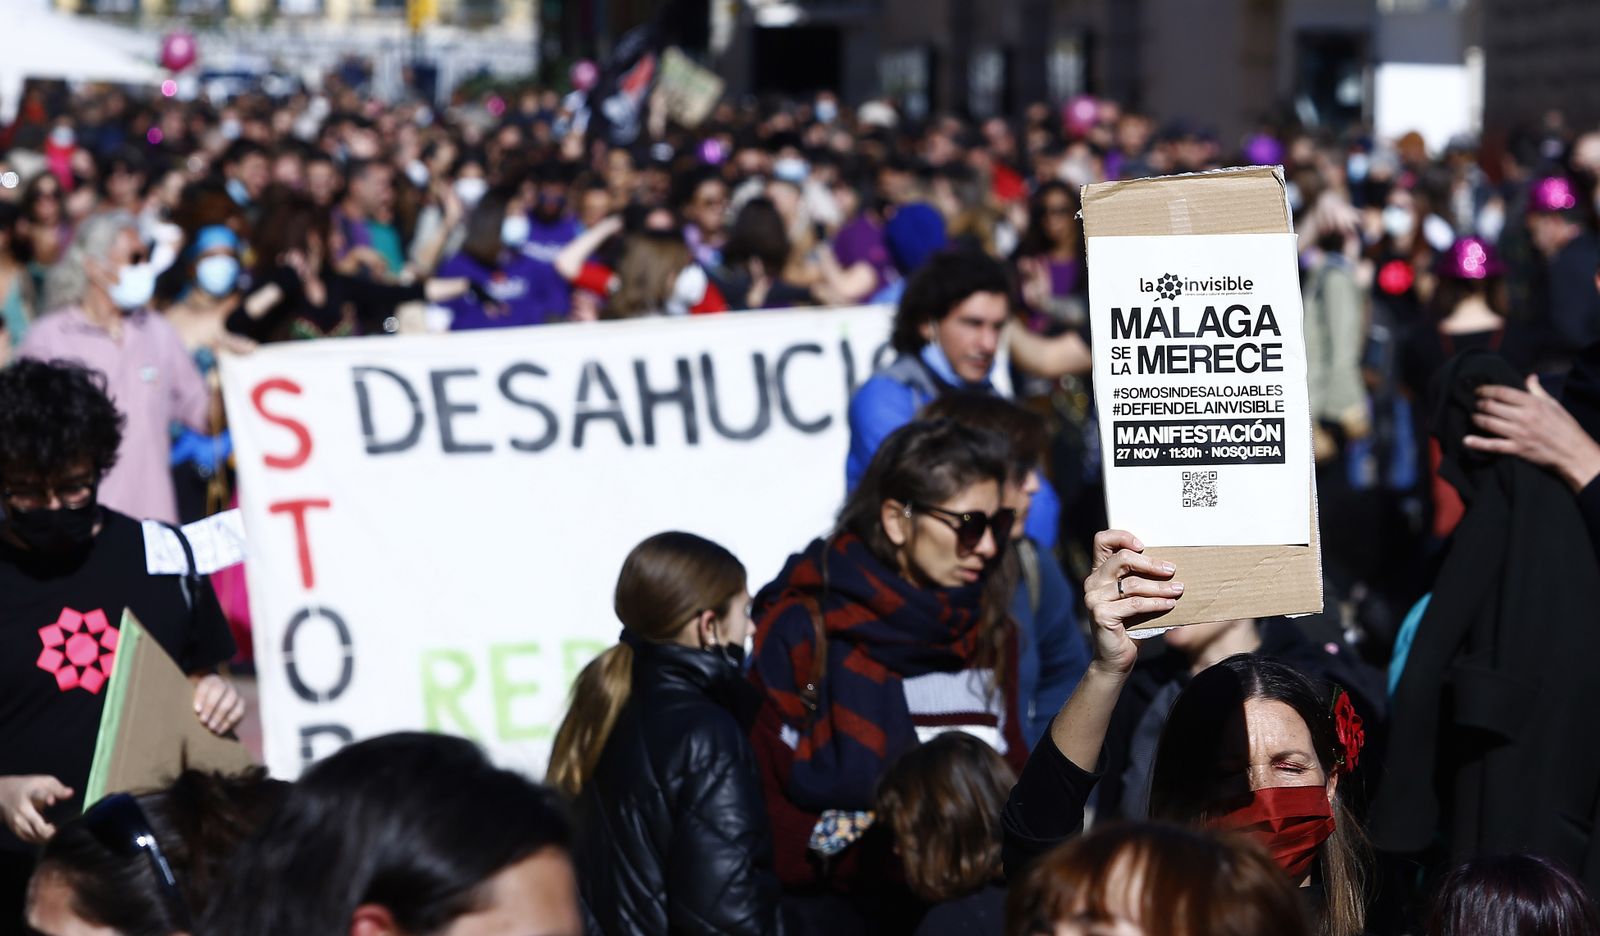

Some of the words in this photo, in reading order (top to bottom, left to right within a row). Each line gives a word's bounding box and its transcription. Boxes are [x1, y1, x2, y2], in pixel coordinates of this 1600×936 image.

[1140, 278, 1154, 293] la
[1184, 275, 1254, 292] invisible
[1110, 297, 1282, 340] MÁLAGA
[1111, 346, 1132, 360] SE
[1137, 342, 1284, 375] MERECE
[1111, 362, 1132, 375] LA
[352, 338, 892, 454] DESAHUCI
[1113, 384, 1284, 399] #SOMOSINDESALOJABLES
[1113, 399, 1285, 416] #DEFIENDELAINVISIBLE
[1117, 419, 1281, 445] MANIFESTACIÓN
[1116, 448, 1131, 460] 27
[1133, 447, 1160, 460] NOV
[1211, 445, 1282, 460] NOSQUERA
